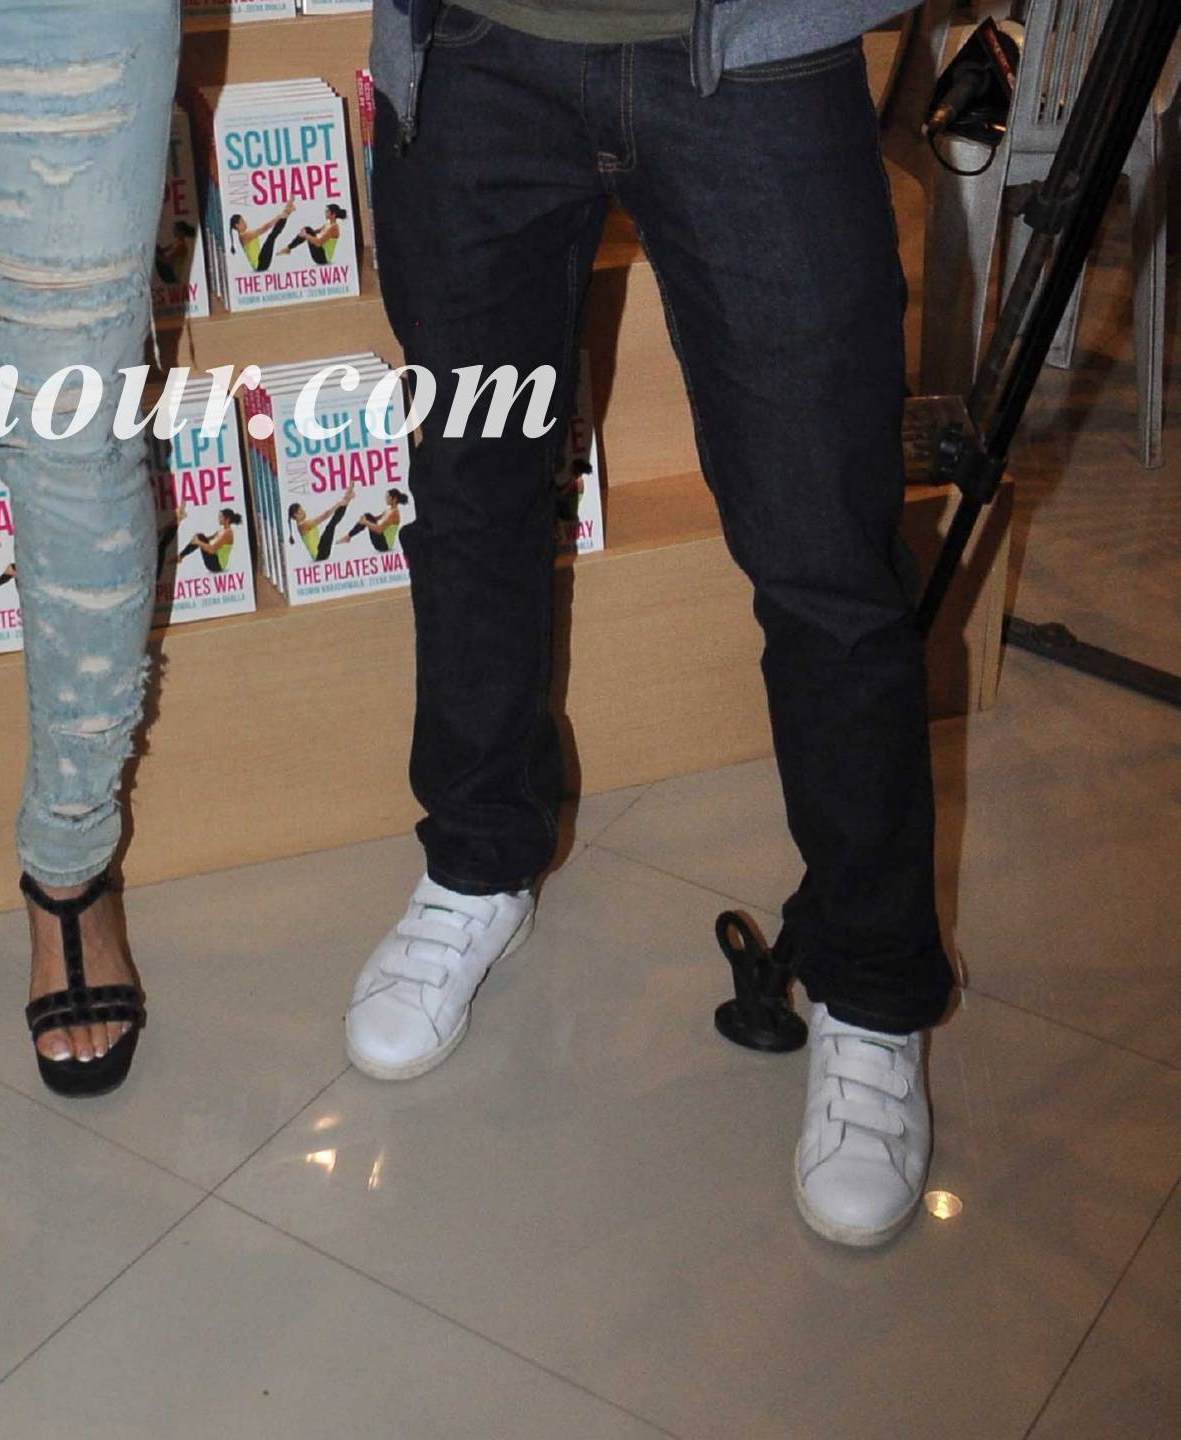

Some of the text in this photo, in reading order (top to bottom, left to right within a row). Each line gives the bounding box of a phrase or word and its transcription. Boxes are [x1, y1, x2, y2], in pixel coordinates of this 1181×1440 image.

[224, 122, 335, 170] SCULPT
[229, 172, 249, 206] AND
[251, 163, 341, 206] SHAPE
[235, 265, 349, 294] THE PILATES WAY
[286, 460, 308, 497] AND
[310, 446, 401, 494] SHAPE
[213, 571, 245, 594] WAY
[294, 565, 321, 586] THE
[324, 557, 378, 581] PILATES
